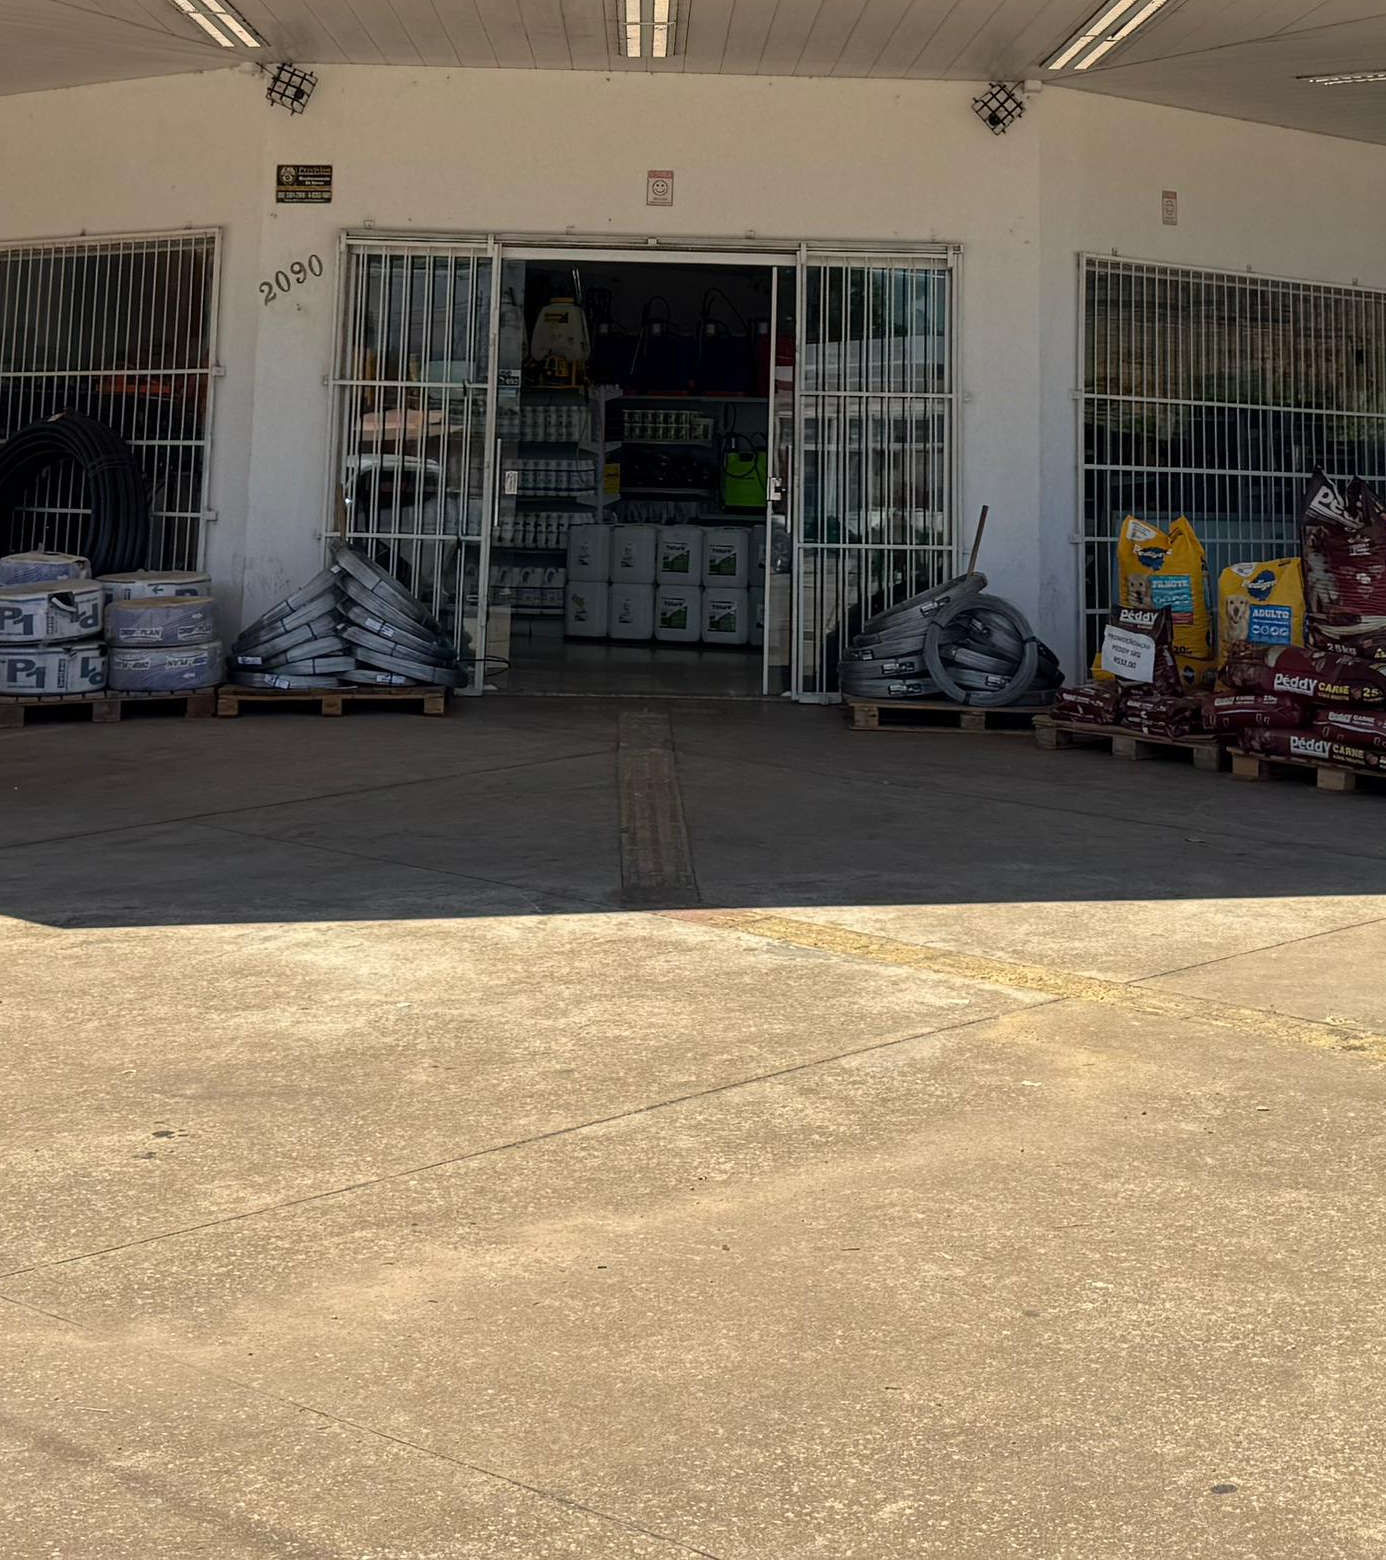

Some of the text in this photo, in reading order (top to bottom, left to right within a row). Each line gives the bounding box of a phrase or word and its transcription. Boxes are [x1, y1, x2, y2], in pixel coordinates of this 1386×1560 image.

[259, 254, 324, 306] 2090
[1119, 608, 1159, 625] Péddy
[1252, 608, 1290, 619] ADULTO
[6, 658, 46, 688] P1
[1273, 672, 1318, 697] Péddy
[1317, 681, 1350, 695] CARNE
[1289, 735, 1332, 759] Péddy
[1331, 743, 1365, 759] CARNE
